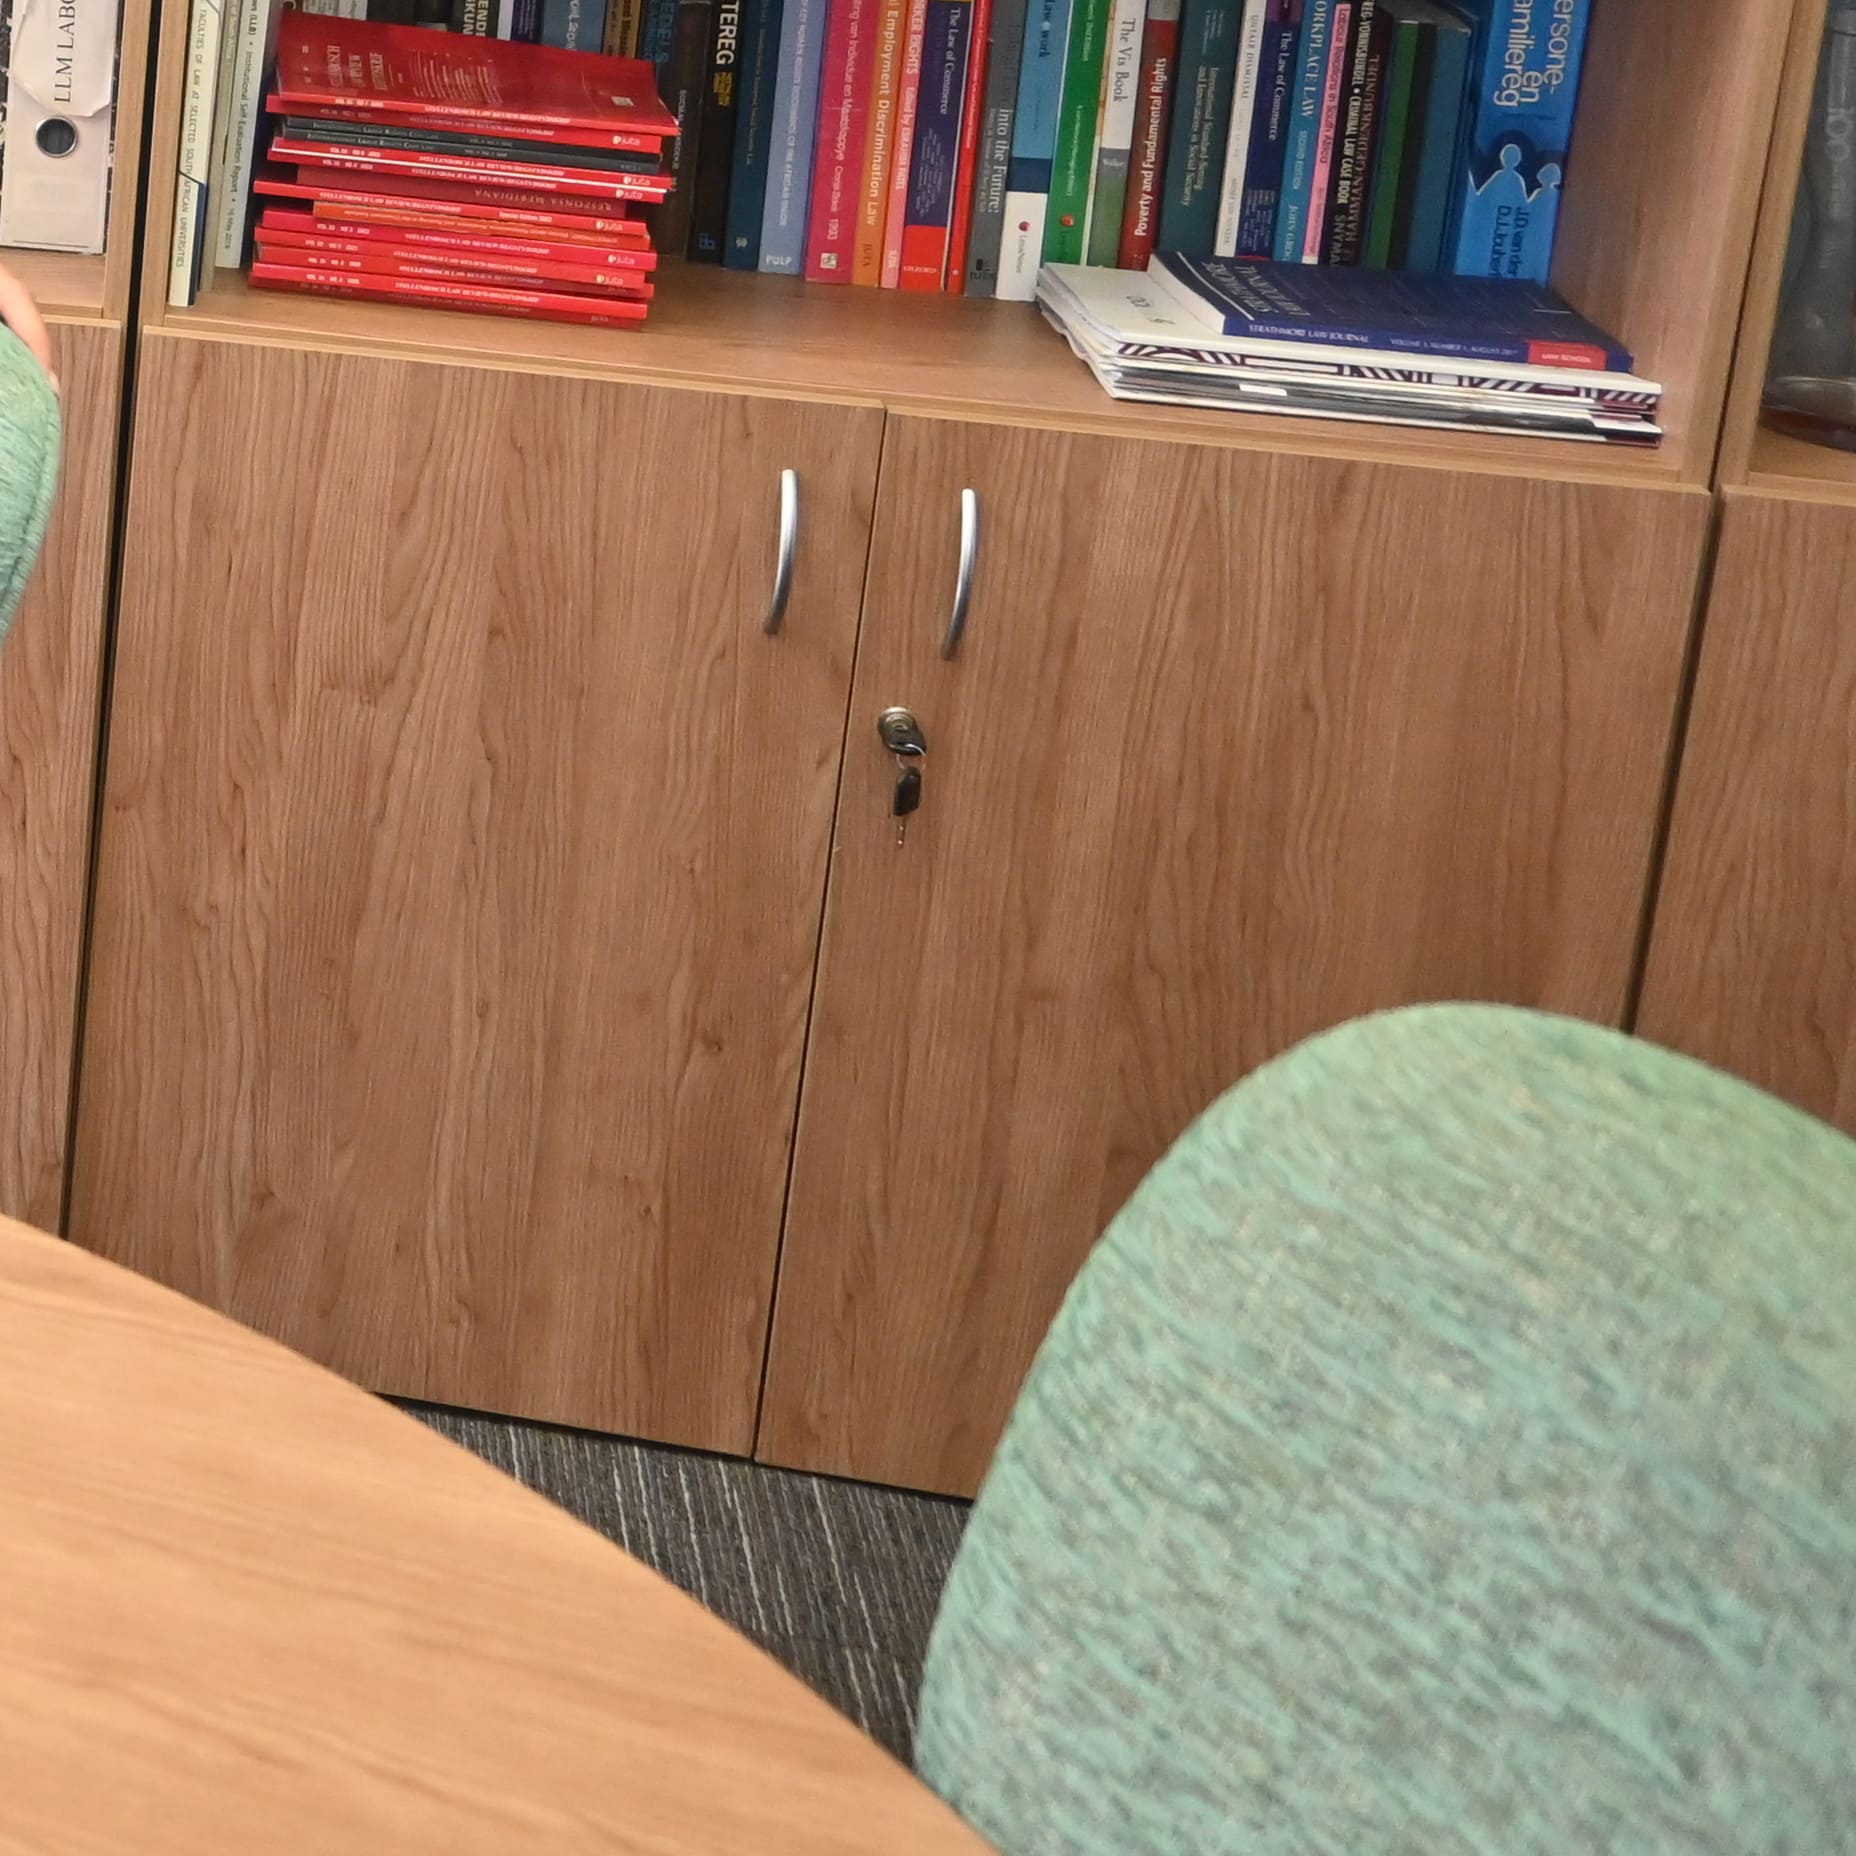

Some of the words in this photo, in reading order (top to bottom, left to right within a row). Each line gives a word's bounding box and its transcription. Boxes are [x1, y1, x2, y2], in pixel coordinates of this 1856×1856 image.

[1119, 18, 1137, 43] The
[877, 9, 900, 96] Employment
[906, 33, 921, 76] RIGHTS
[1116, 45, 1135, 68] Vis
[54, 45, 74, 104] LLM
[1112, 71, 1131, 103] Book
[1150, 57, 1169, 93] Rights
[1521, 70, 1546, 103] en
[902, 87, 916, 113] Edited
[1300, 86, 1319, 120] LAW
[901, 114, 913, 126] by
[1140, 95, 1164, 169] Fundamental
[869, 99, 892, 198] Discrimination
[992, 138, 1009, 162] the
[987, 164, 1007, 214] Future:
[1139, 170, 1157, 192] and
[866, 201, 882, 226] Law
[1132, 192, 1154, 236] Poverty
